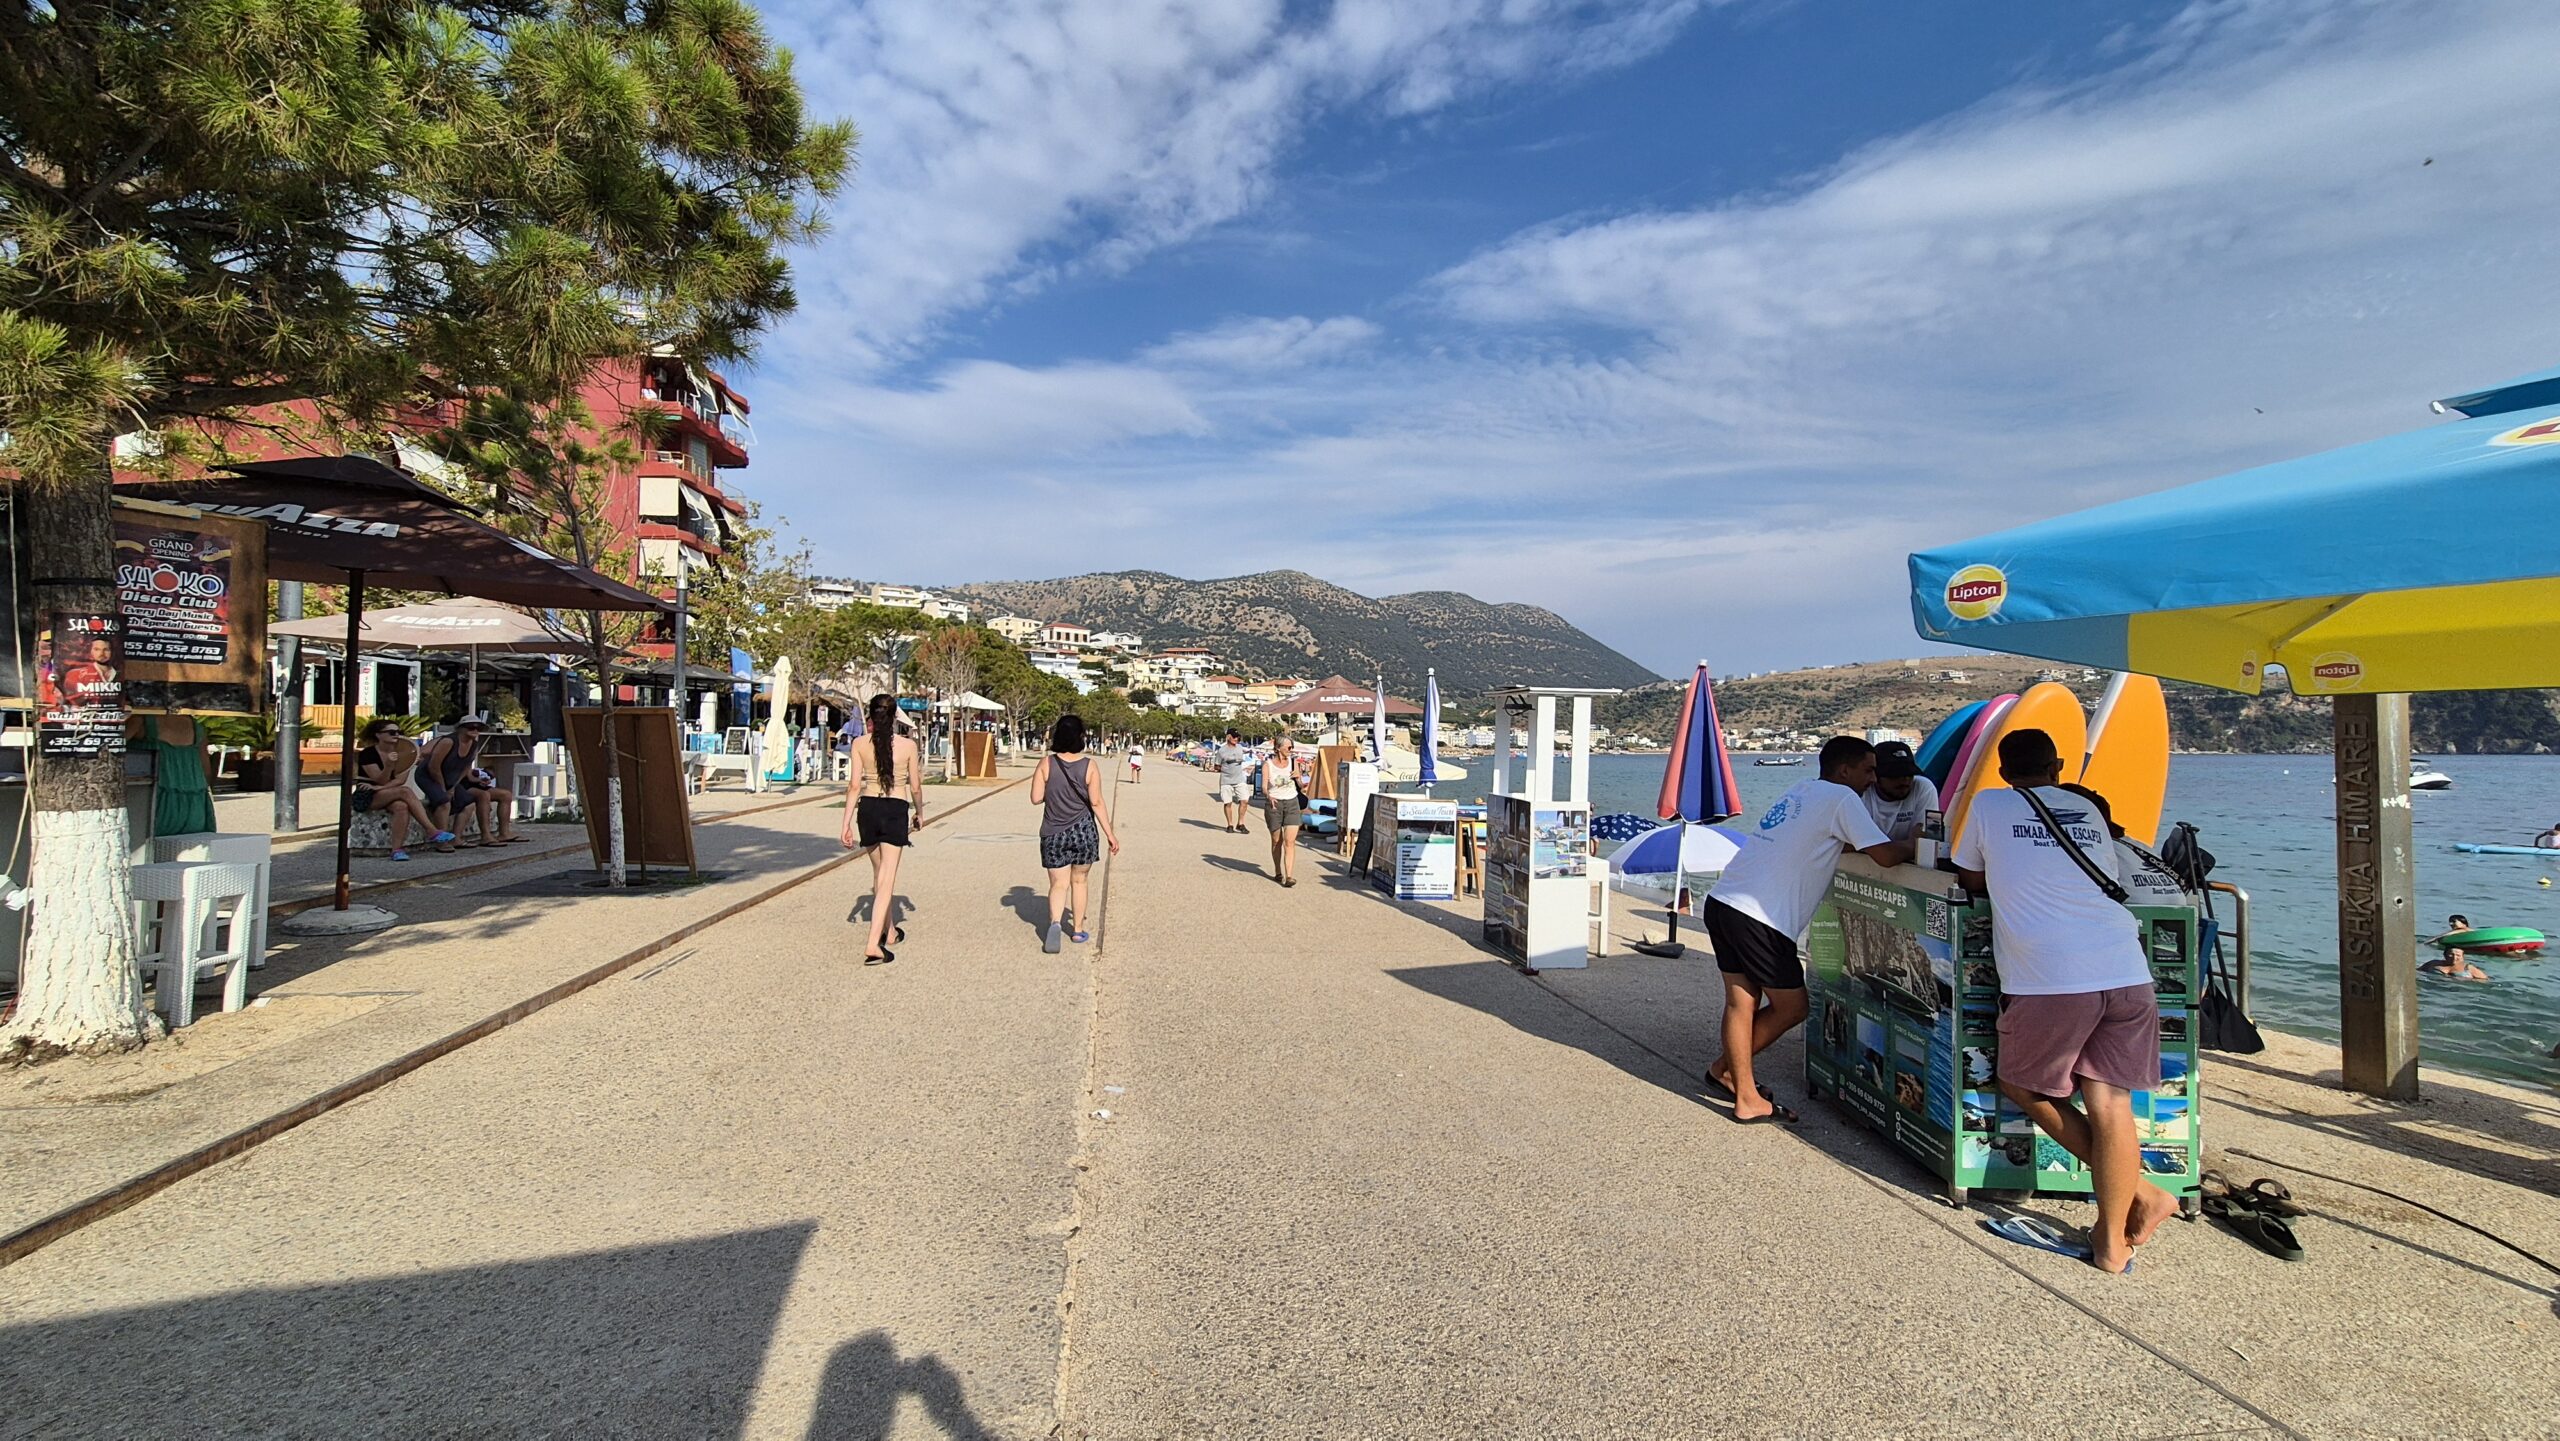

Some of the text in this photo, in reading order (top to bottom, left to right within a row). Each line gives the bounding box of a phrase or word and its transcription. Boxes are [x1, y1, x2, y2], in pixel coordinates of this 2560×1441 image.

[148, 538, 194, 552] GRAND
[152, 547, 191, 558] OPENING
[116, 563, 225, 597] SHÔKO
[120, 590, 218, 609] Disco Club
[1952, 585, 1997, 600] Lipton
[123, 605, 213, 621] Every Day Music
[382, 615, 502, 626] LAVAZZA
[141, 618, 181, 629] Special
[183, 622, 222, 632] Guests
[146, 643, 162, 651] 69
[165, 644, 188, 653] 552
[190, 646, 221, 655] 8763
[48, 737, 80, 746] +355
[83, 737, 101, 746] 69
[2012, 824, 2052, 840] HIMARA
[2033, 839, 2050, 848] Boat
[2148, 856, 2180, 881] adidas
[1834, 877, 1907, 909] HIMARA SEA ESCAPES
[2344, 861, 2375, 1001] BASHKIA
